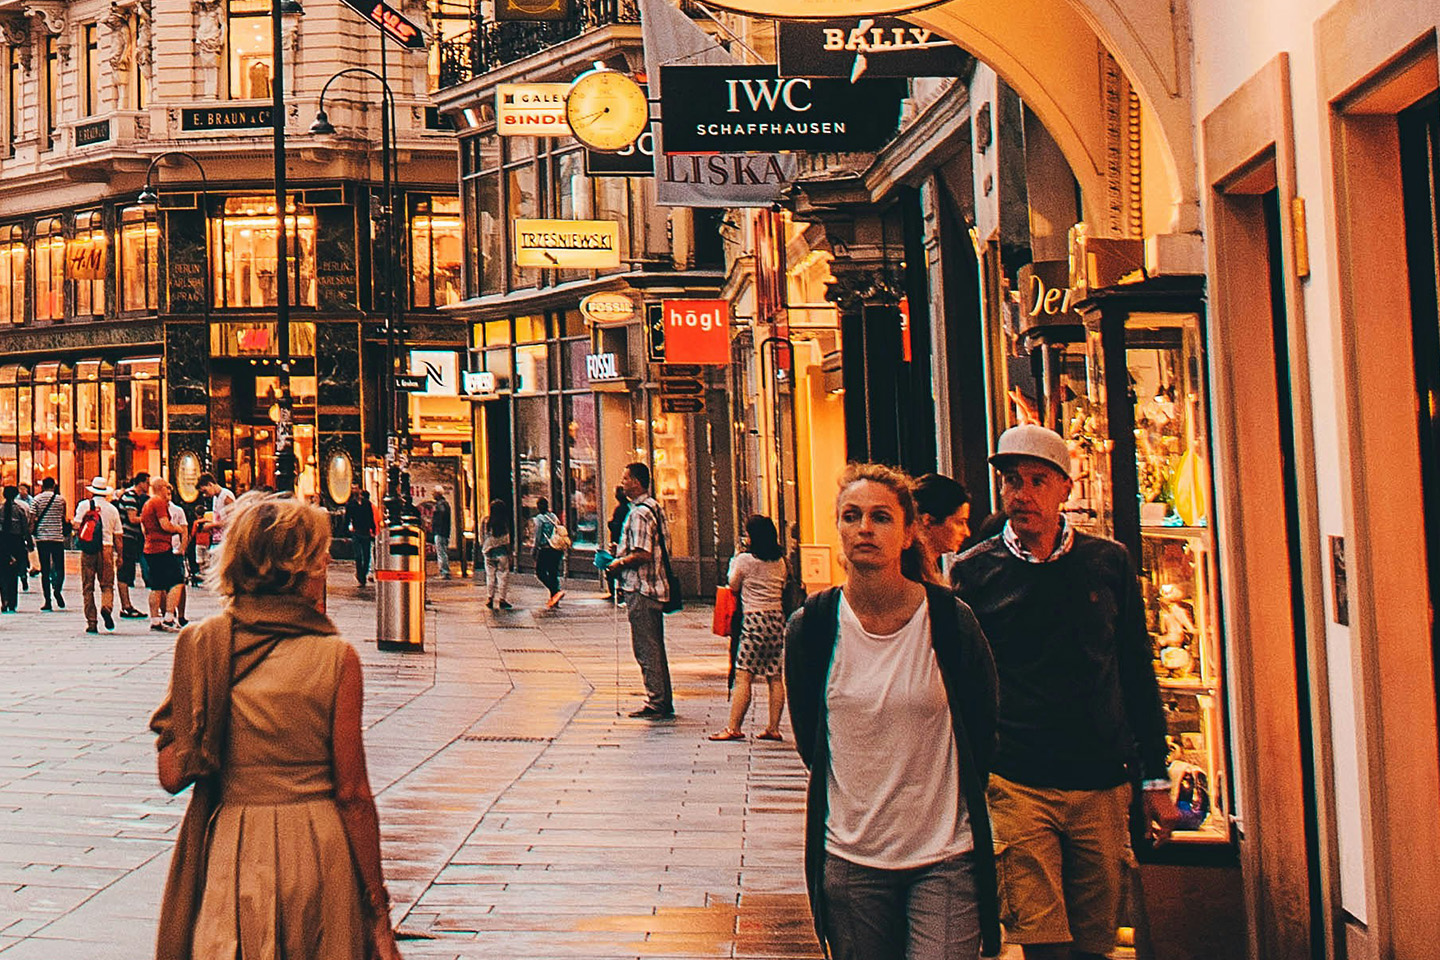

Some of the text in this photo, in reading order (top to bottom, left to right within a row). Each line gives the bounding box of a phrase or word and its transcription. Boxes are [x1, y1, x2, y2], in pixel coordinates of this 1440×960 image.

[823, 28, 933, 51] BALLY
[725, 78, 812, 112] IWC
[193, 113, 203, 125] E.
[208, 112, 246, 125] BRAUN
[696, 122, 846, 136] SCHAFFHAUSEN
[664, 153, 790, 185] LISKA
[588, 302, 634, 312] FOSSIL
[586, 353, 618, 379] FOSSIL
